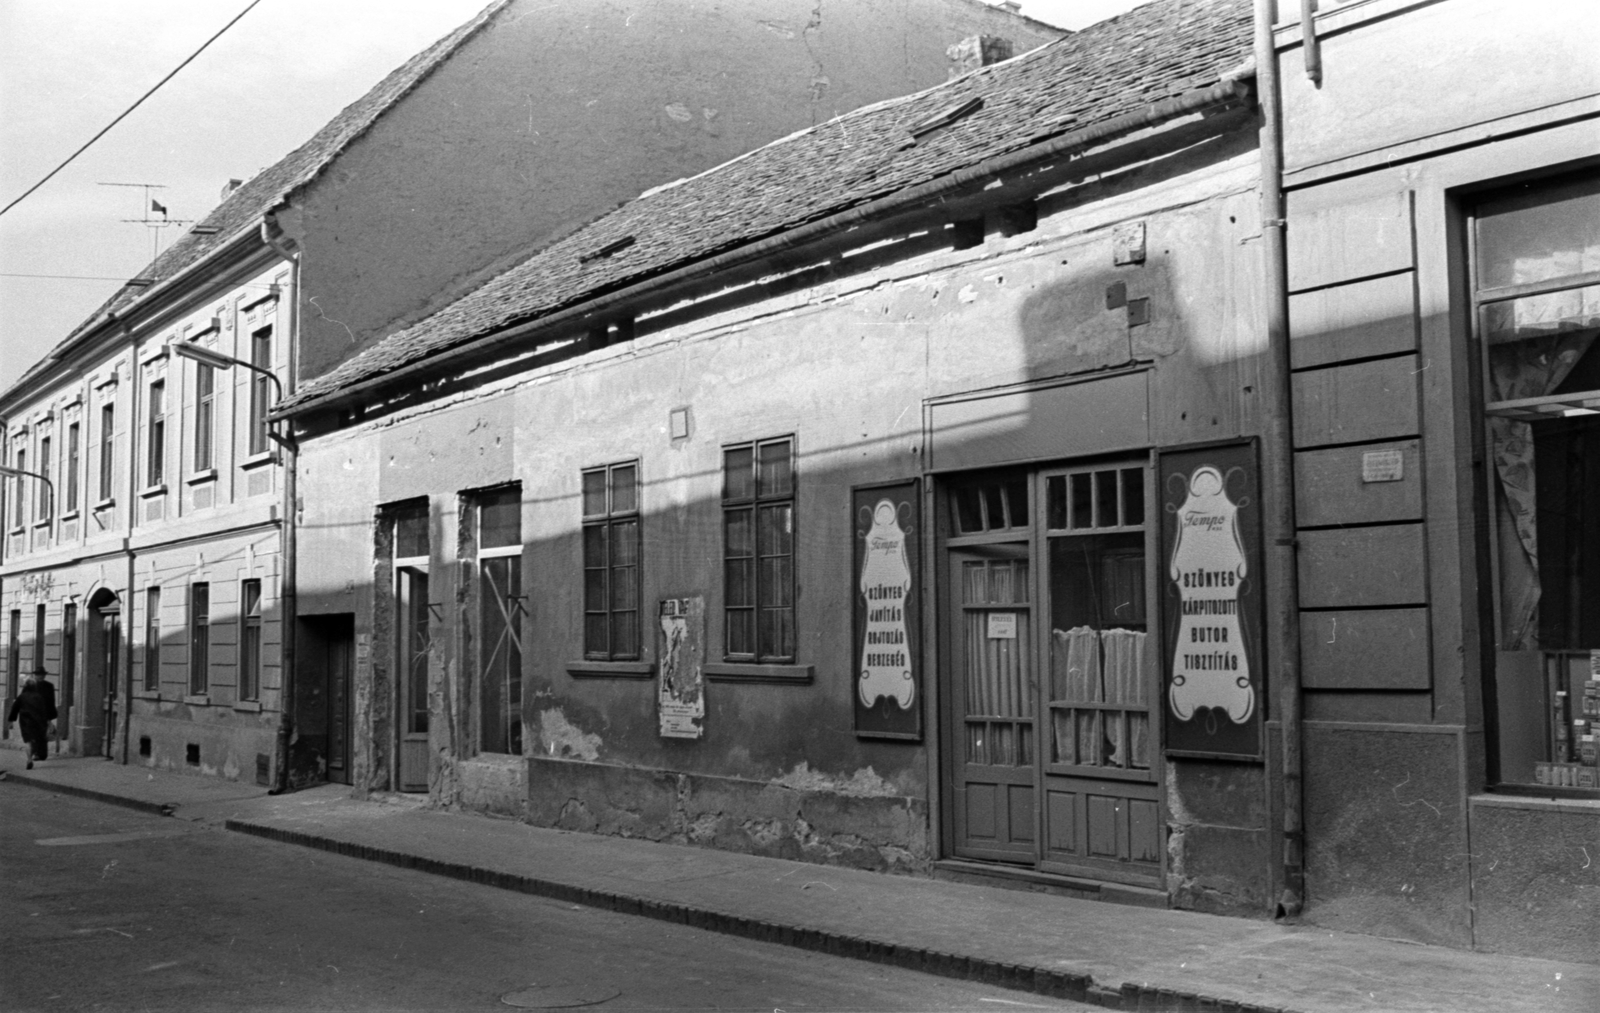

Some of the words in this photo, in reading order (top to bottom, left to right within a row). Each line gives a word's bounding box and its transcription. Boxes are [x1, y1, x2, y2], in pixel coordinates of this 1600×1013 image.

[1184, 511, 1225, 531] Tempo
[871, 537, 900, 555] Tempo
[870, 606, 901, 622] JAVÍTÁS
[1183, 597, 1237, 615] KÁRPITOZOTT
[868, 628, 903, 644] ROJTOZÁS
[1191, 627, 1228, 642] BUTOR
[867, 650, 905, 667] BESZEGÉS
[1184, 651, 1238, 670] TISZTÍTÁS
